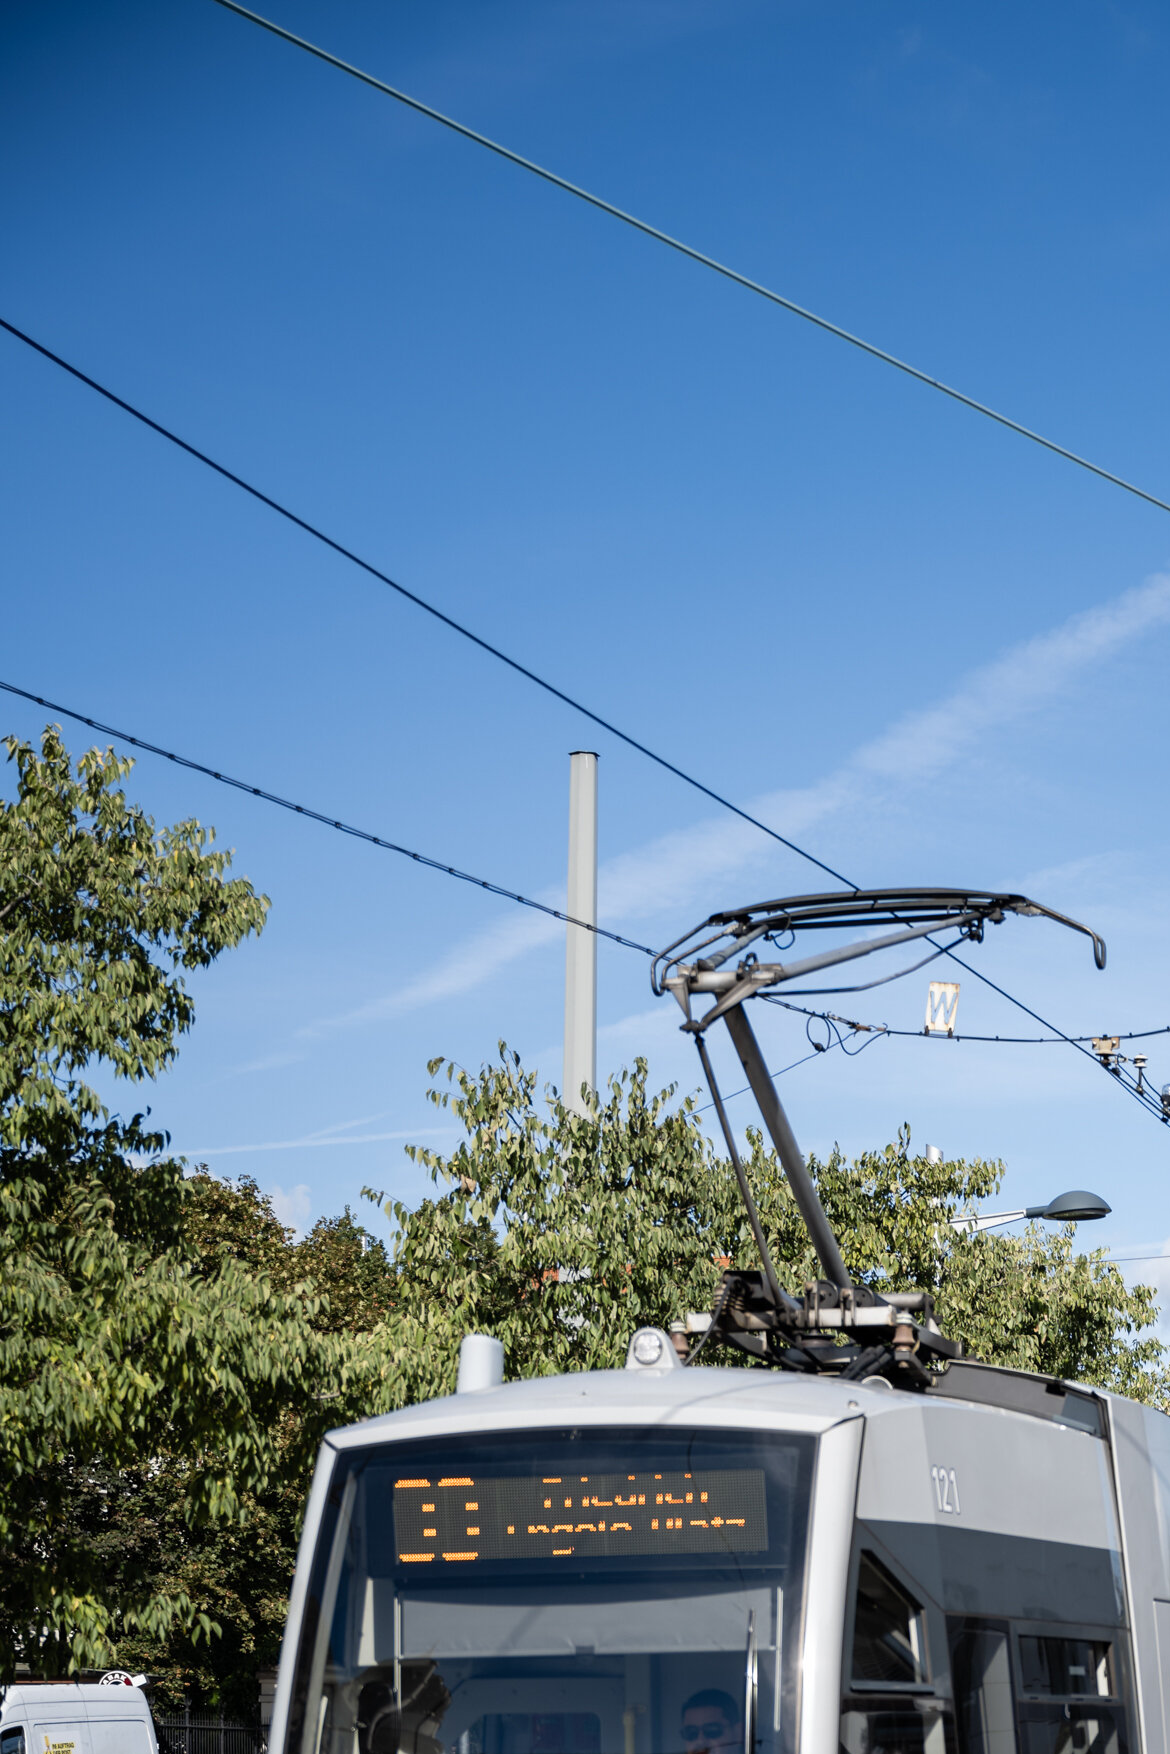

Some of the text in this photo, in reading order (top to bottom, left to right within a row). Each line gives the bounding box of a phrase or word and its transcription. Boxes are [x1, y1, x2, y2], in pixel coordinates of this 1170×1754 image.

[930, 991, 958, 1025] W
[931, 1465, 961, 1515] 121
[103, 1673, 127, 1686] ABAK
